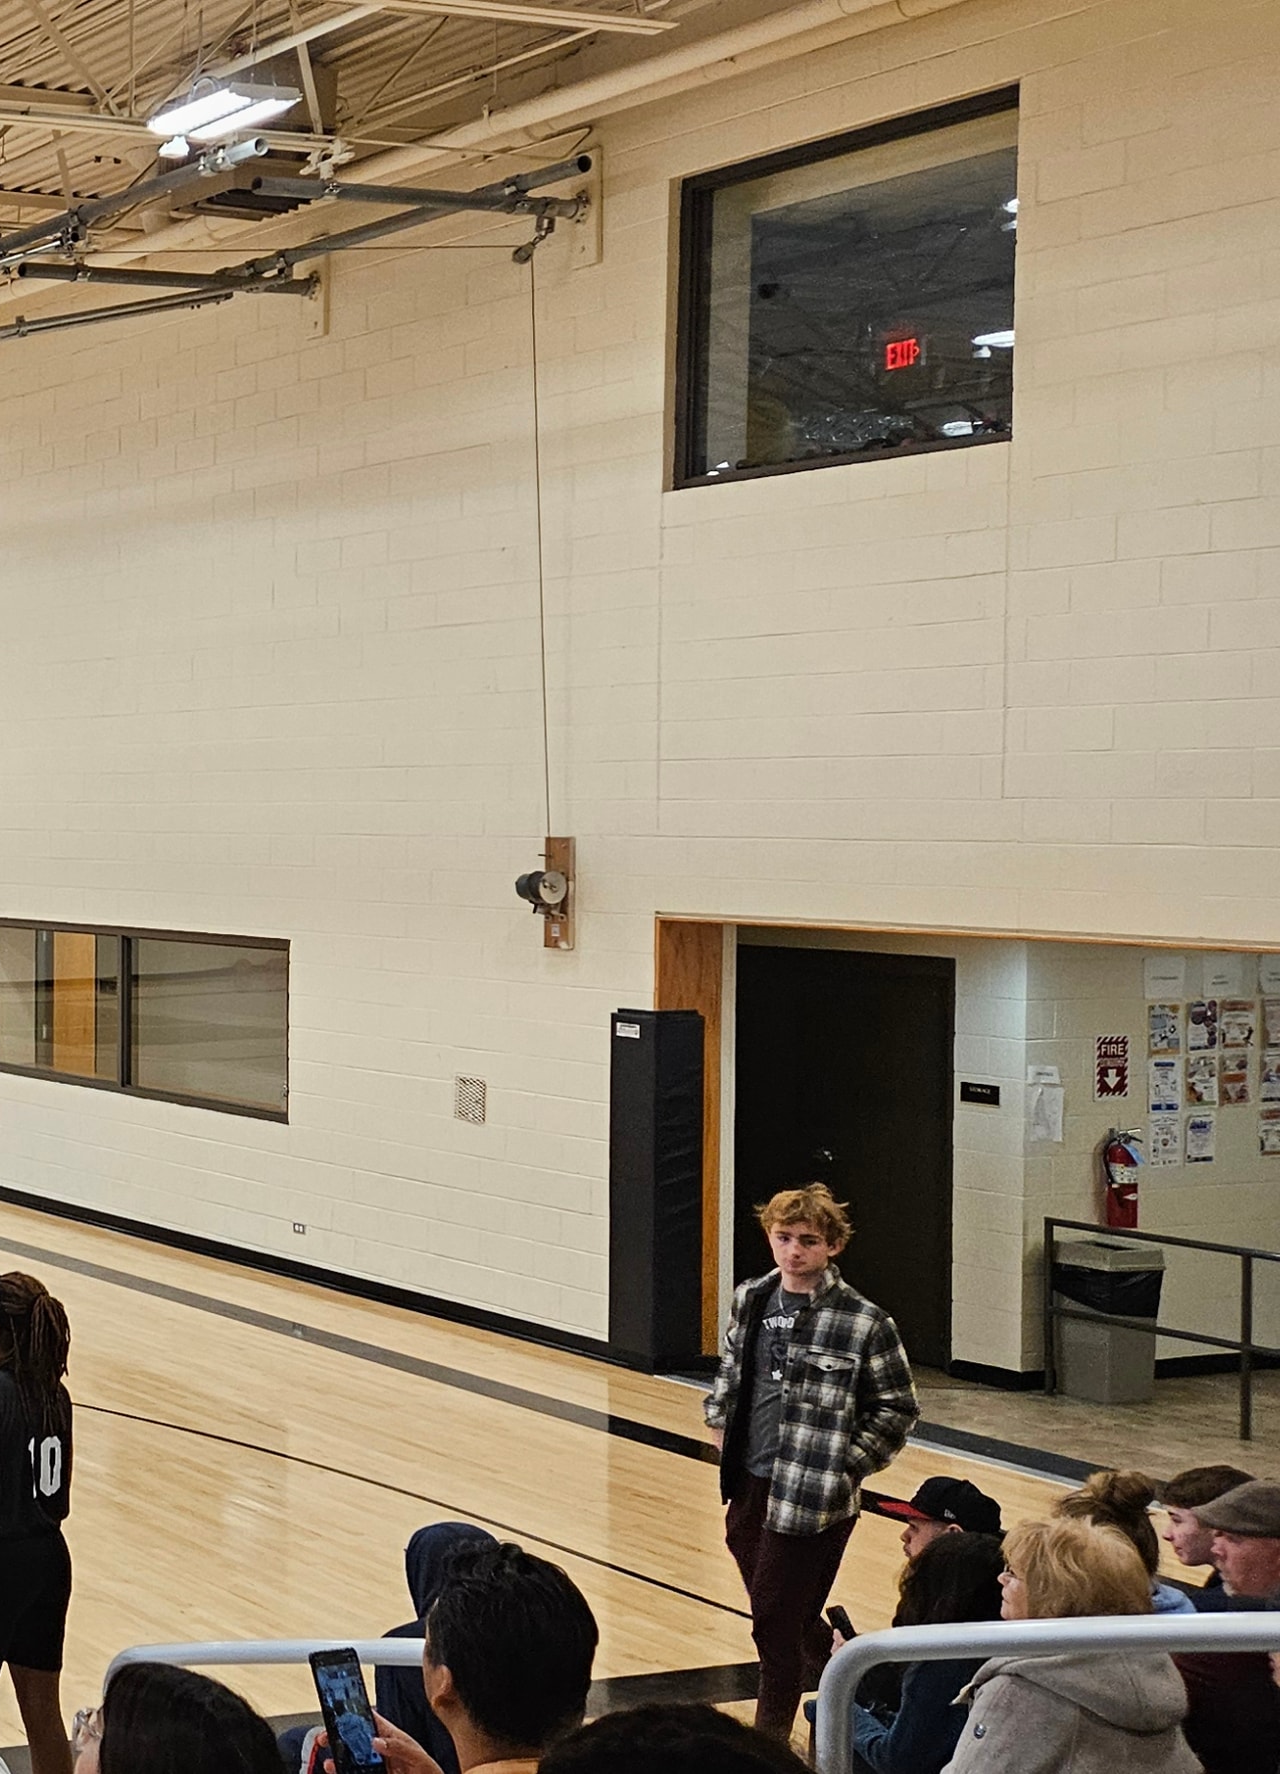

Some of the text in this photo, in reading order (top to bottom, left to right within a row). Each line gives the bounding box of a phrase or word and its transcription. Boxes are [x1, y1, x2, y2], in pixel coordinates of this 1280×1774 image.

[885, 338, 918, 370] EXIT
[1101, 1044, 1125, 1056] FIRE
[28, 1435, 62, 1499] 10
